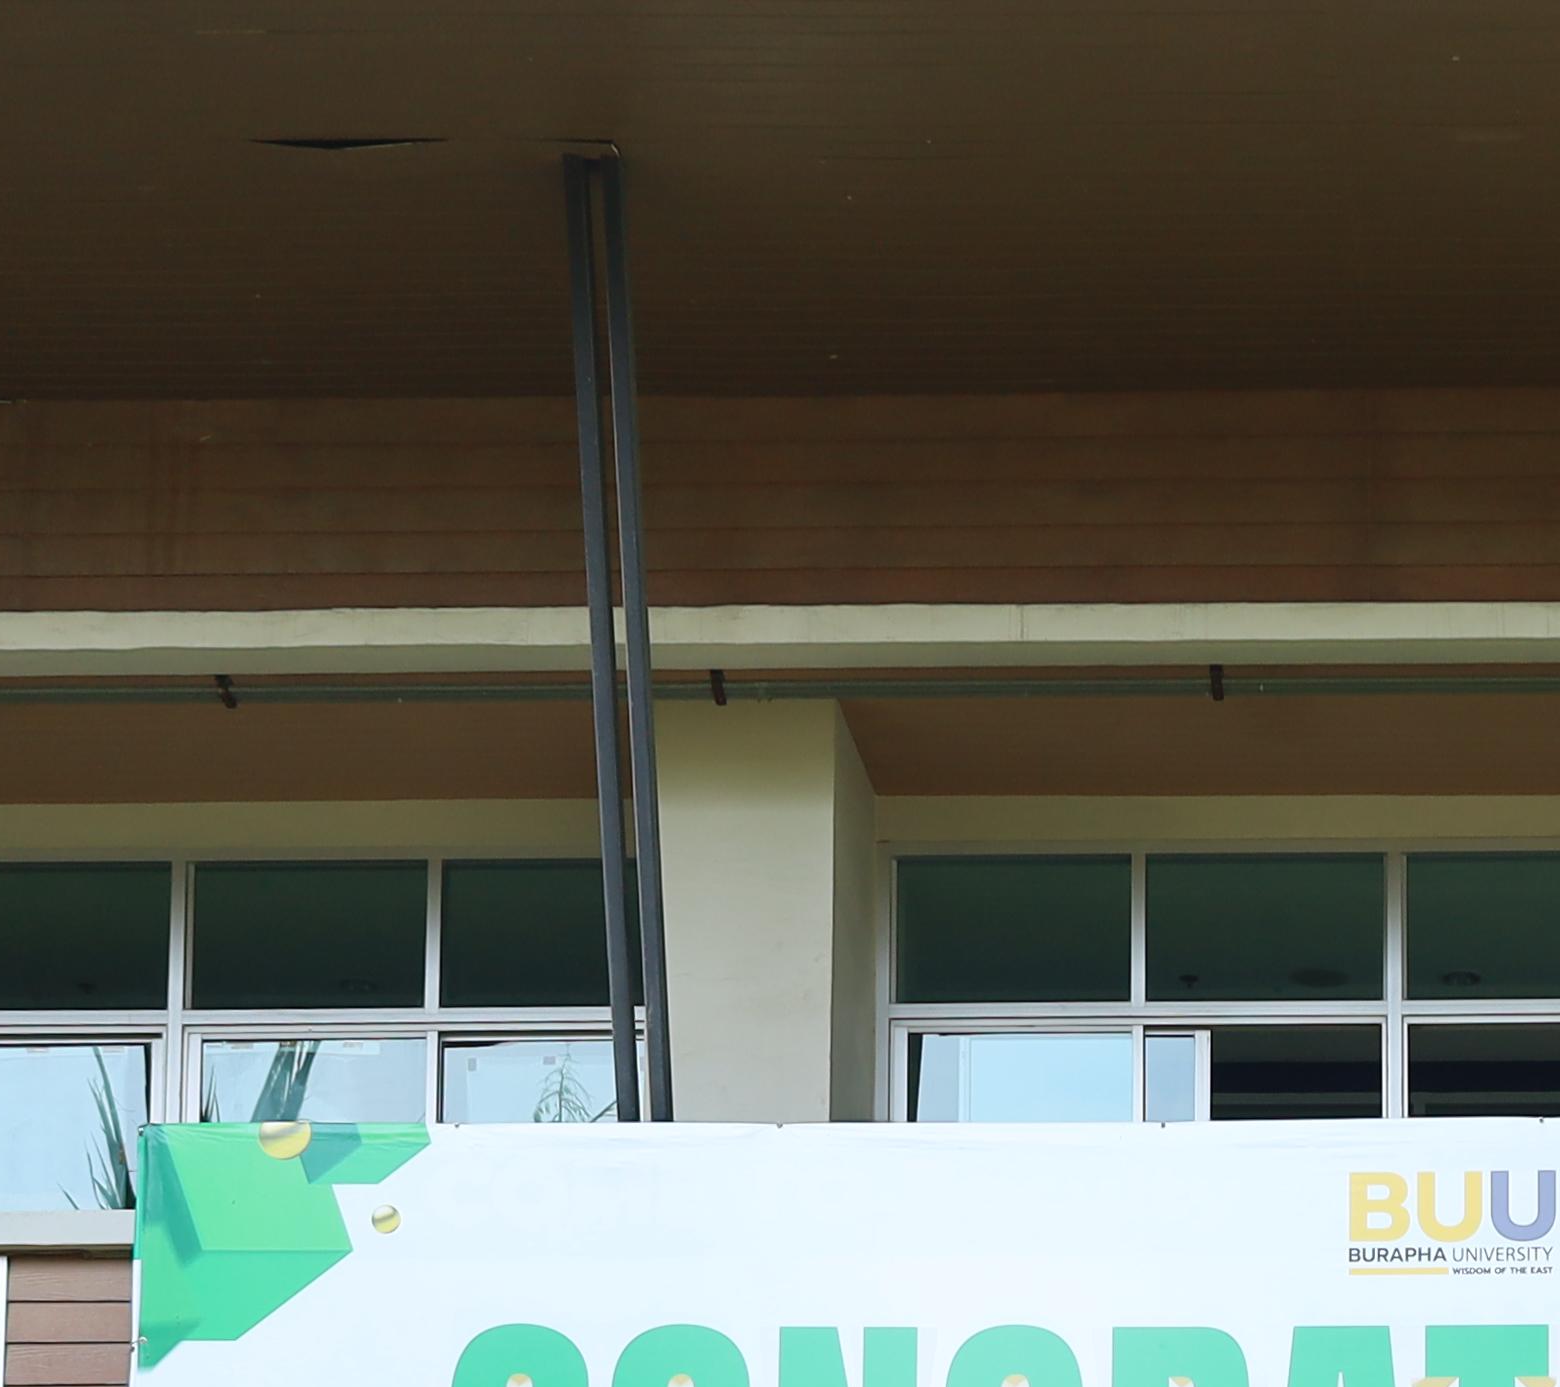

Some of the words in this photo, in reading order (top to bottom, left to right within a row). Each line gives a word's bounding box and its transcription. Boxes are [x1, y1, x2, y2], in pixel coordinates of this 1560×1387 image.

[1348, 1169, 1557, 1242] BUU
[1348, 1247, 1448, 1263] BURAPHA
[1452, 1246, 1554, 1262] UNIVERSITY
[1452, 1266, 1492, 1275] WISDOM
[1494, 1266, 1507, 1275] OF
[1510, 1266, 1527, 1275] THE
[1530, 1266, 1554, 1275] EAST
